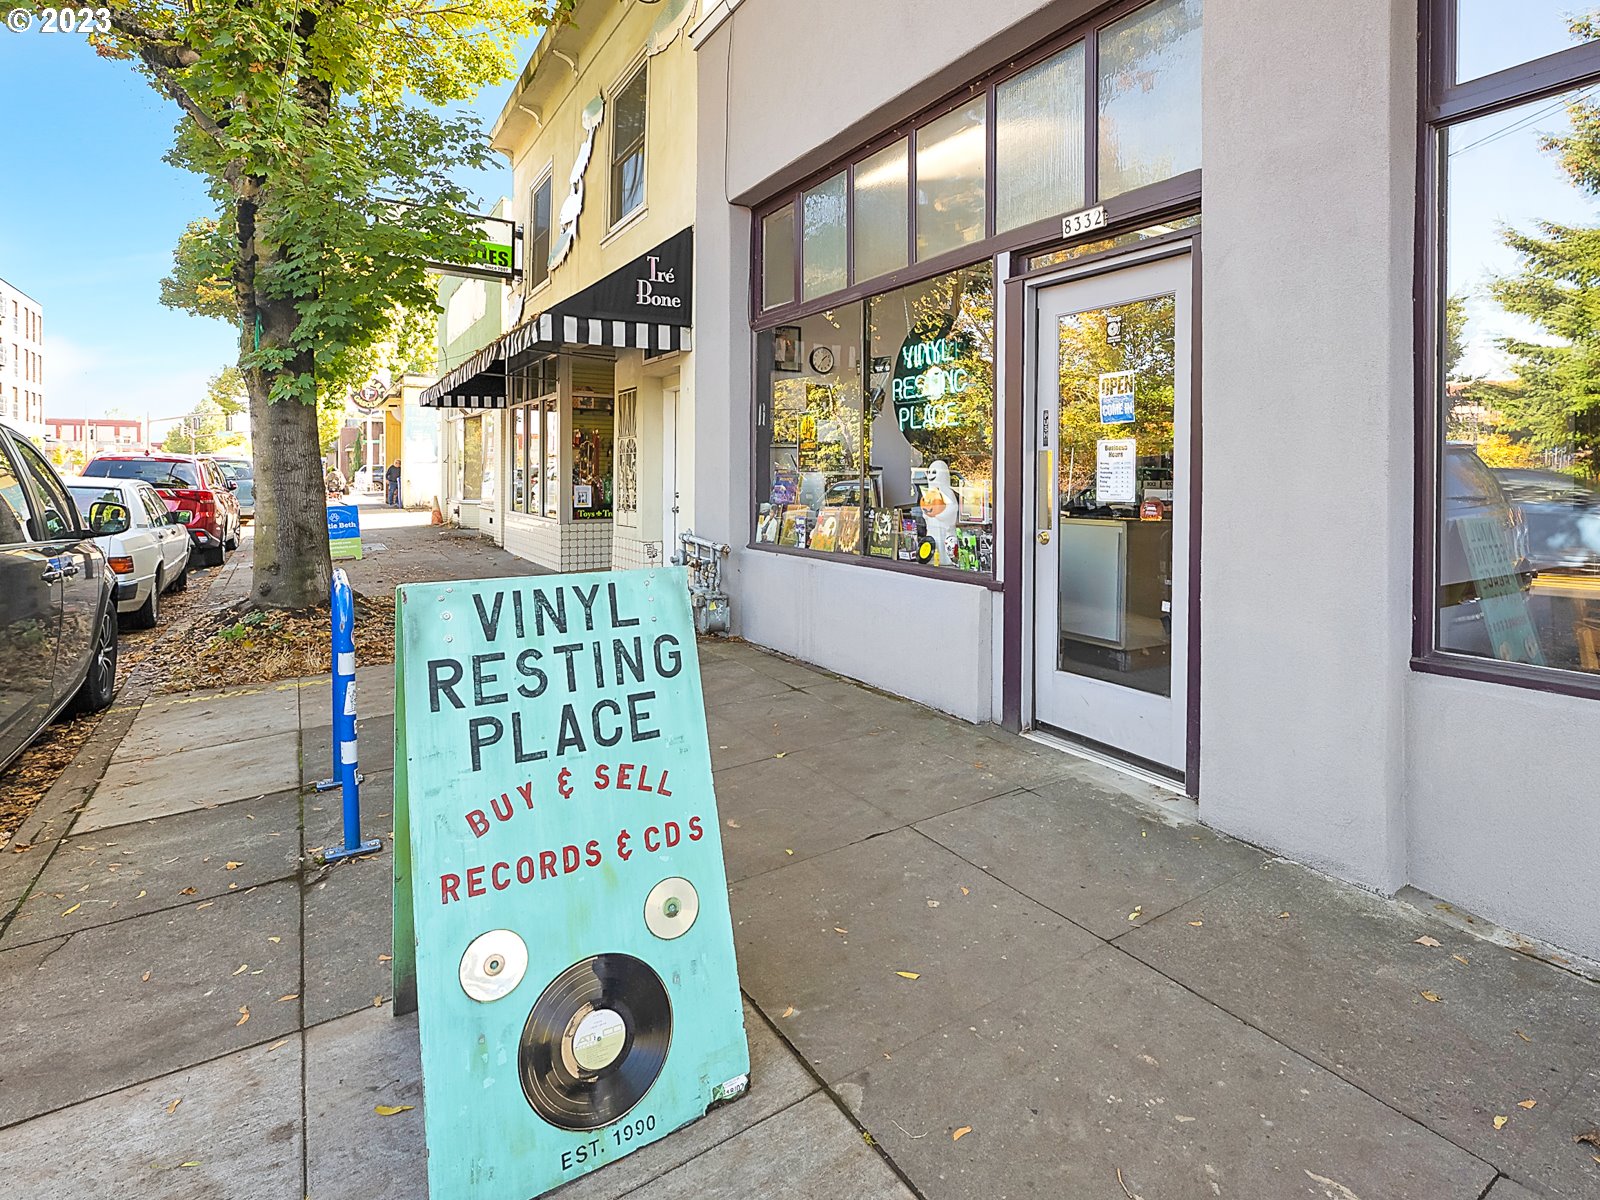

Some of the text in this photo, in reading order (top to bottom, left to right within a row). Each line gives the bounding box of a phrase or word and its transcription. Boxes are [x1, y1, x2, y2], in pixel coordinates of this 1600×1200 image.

[1064, 210, 1102, 234] 8332
[646, 255, 675, 283] Tré
[636, 279, 681, 308] Bone
[1102, 374, 1134, 396] OPEN
[899, 402, 960, 432] PLACE
[339, 521, 356, 529] Beth
[577, 510, 595, 519] Toys
[472, 582, 640, 642] VINYL
[427, 634, 682, 712] RESTING
[469, 691, 661, 772] PLACE
[465, 764, 673, 838] BUY & SELL
[440, 816, 704, 904] RECORDS & CDS
[561, 1115, 656, 1171] EST. 1990
